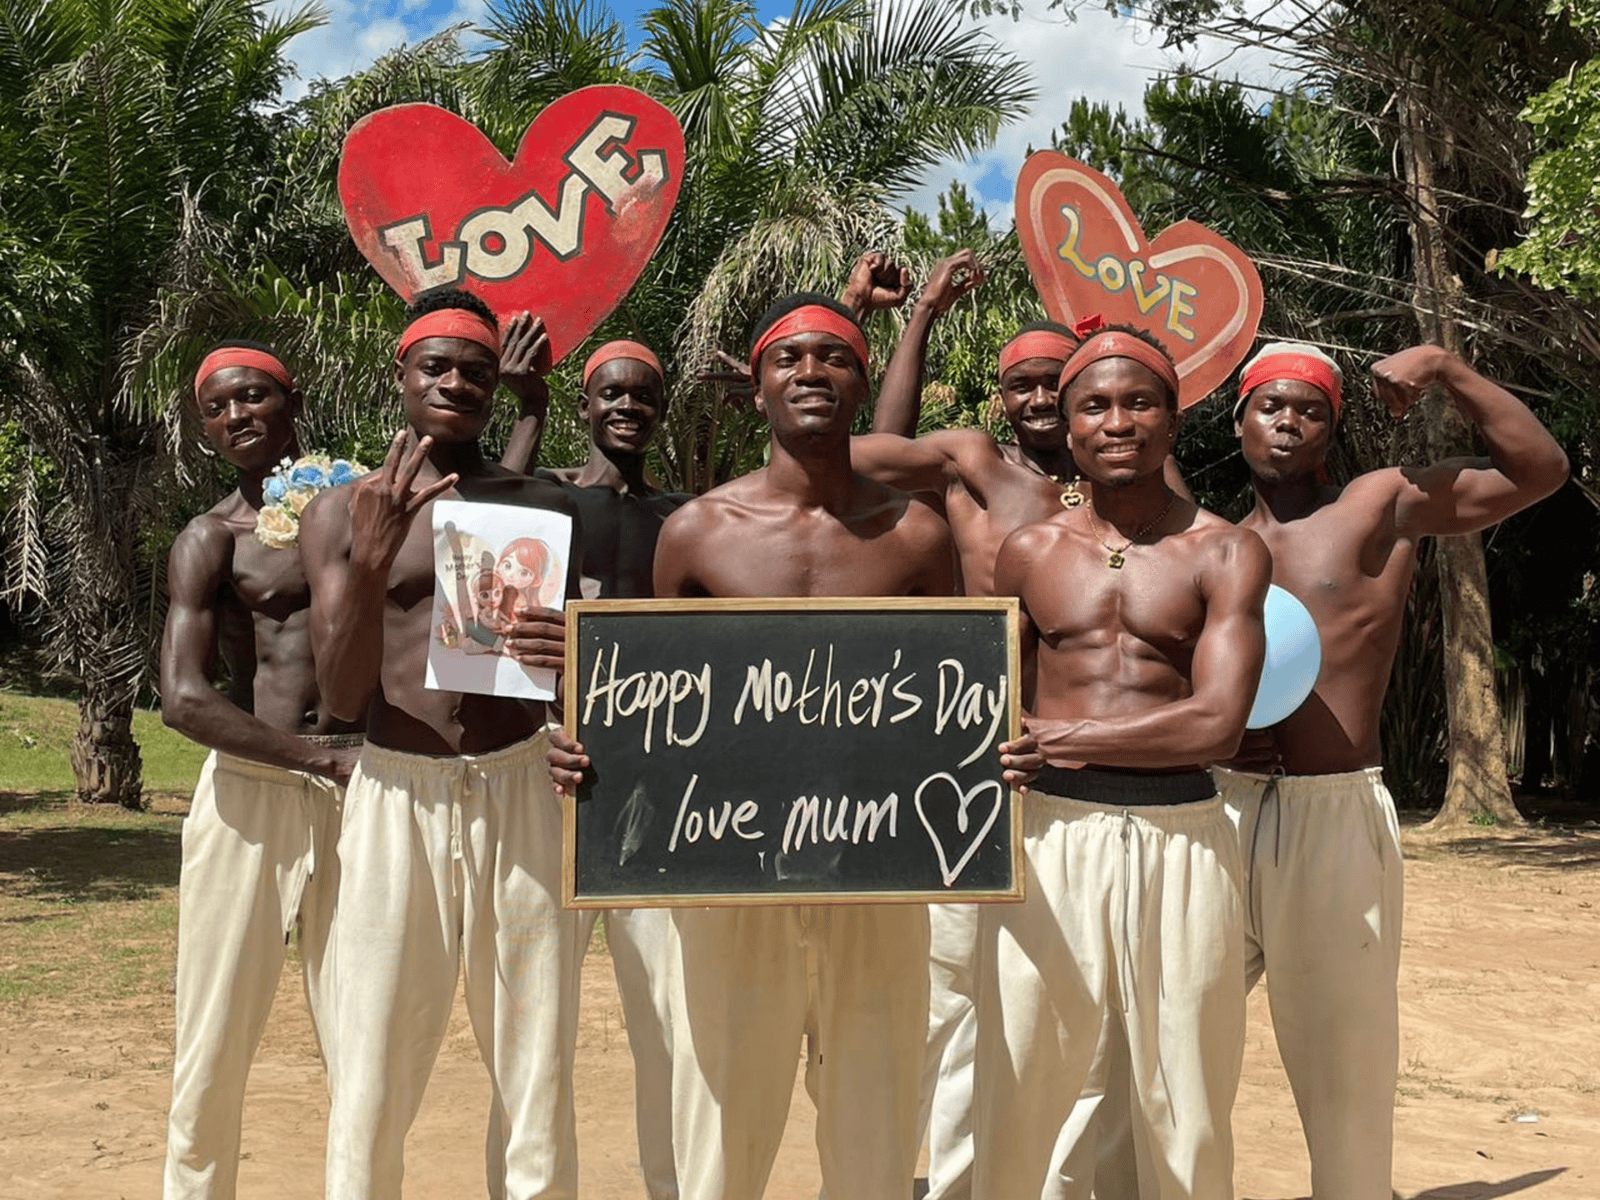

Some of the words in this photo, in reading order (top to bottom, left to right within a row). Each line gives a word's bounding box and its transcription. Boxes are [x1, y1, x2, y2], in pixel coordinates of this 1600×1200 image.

[379, 111, 670, 296] LOVE
[1059, 205, 1198, 342] LOVE
[582, 642, 711, 753] Happy
[733, 643, 922, 728] Mother's
[934, 658, 1007, 769] Day
[668, 773, 765, 853] love
